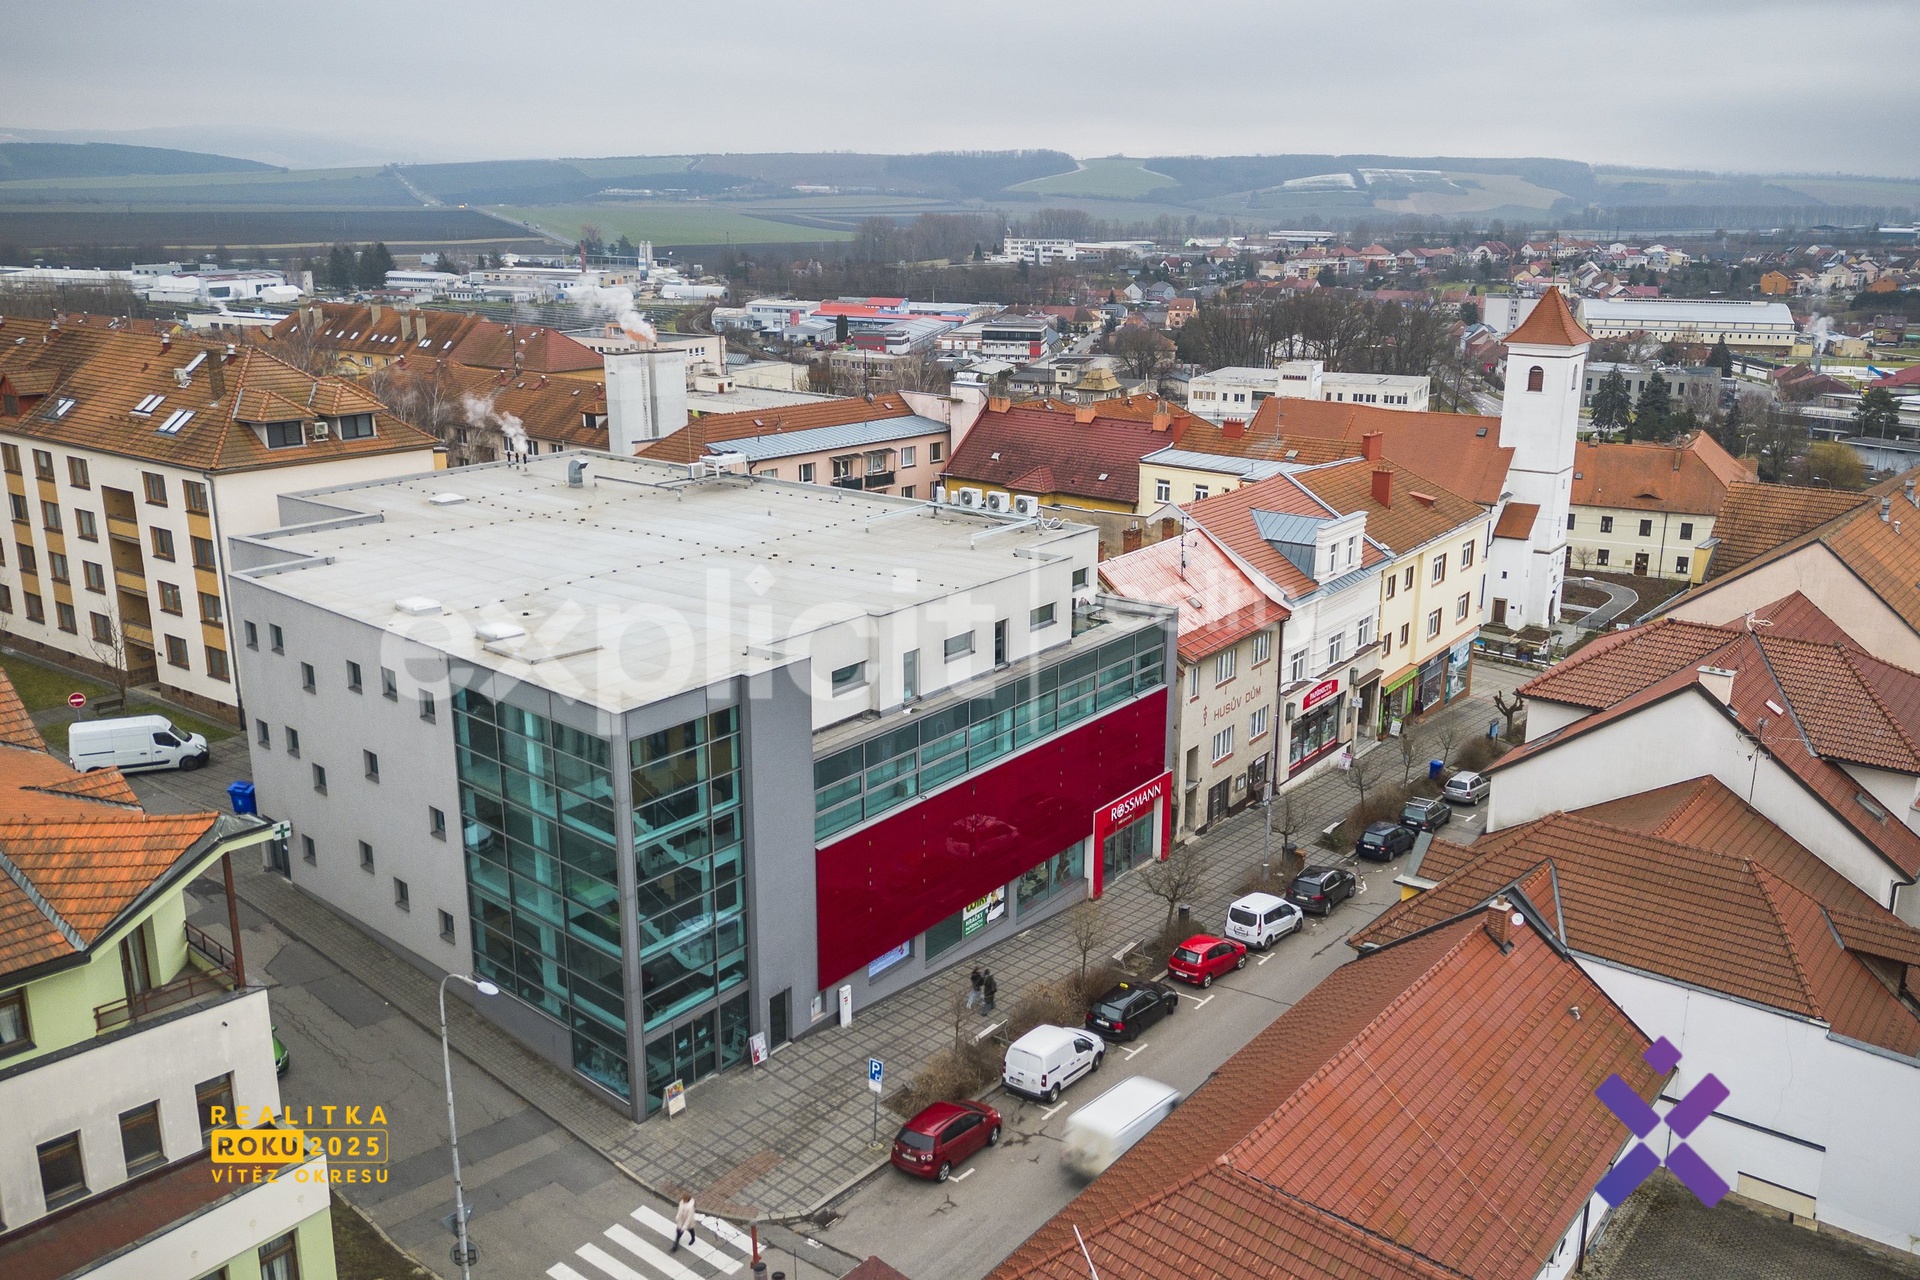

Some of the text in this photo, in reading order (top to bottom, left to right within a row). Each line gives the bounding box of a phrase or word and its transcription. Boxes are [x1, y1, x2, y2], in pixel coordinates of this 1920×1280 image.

[1213, 685, 1262, 720] HUSŮV DŮM
[1110, 782, 1162, 821] ROSSMANN
[872, 1061, 880, 1074] P
